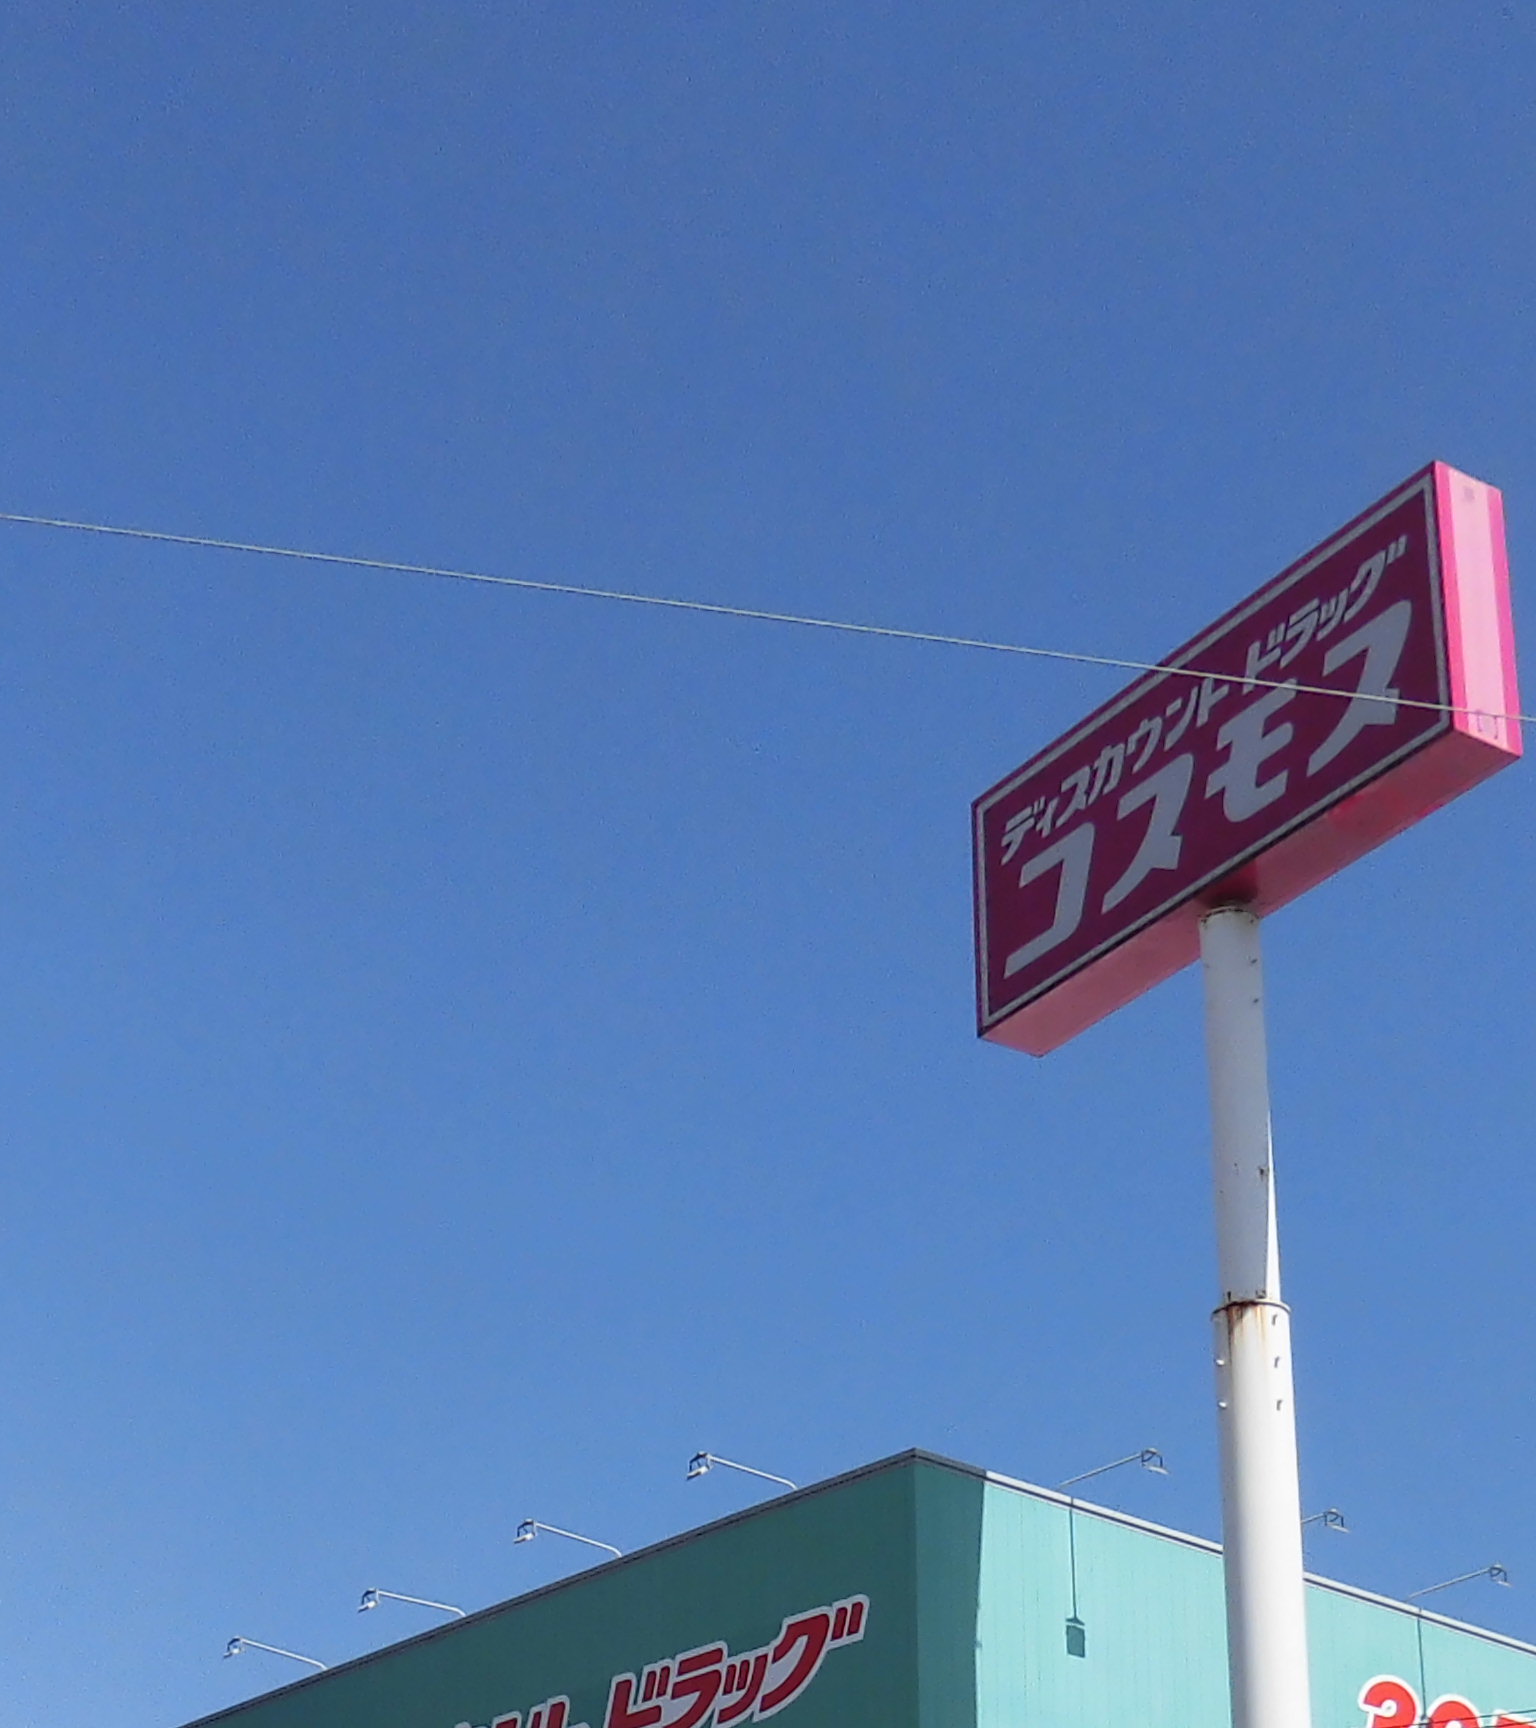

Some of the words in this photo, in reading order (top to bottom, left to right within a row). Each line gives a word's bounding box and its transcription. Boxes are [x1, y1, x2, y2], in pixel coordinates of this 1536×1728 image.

[1000, 673, 1230, 864] ディスカウント
[1242, 534, 1408, 692] ドラッグ
[1004, 599, 1413, 979] コスモス
